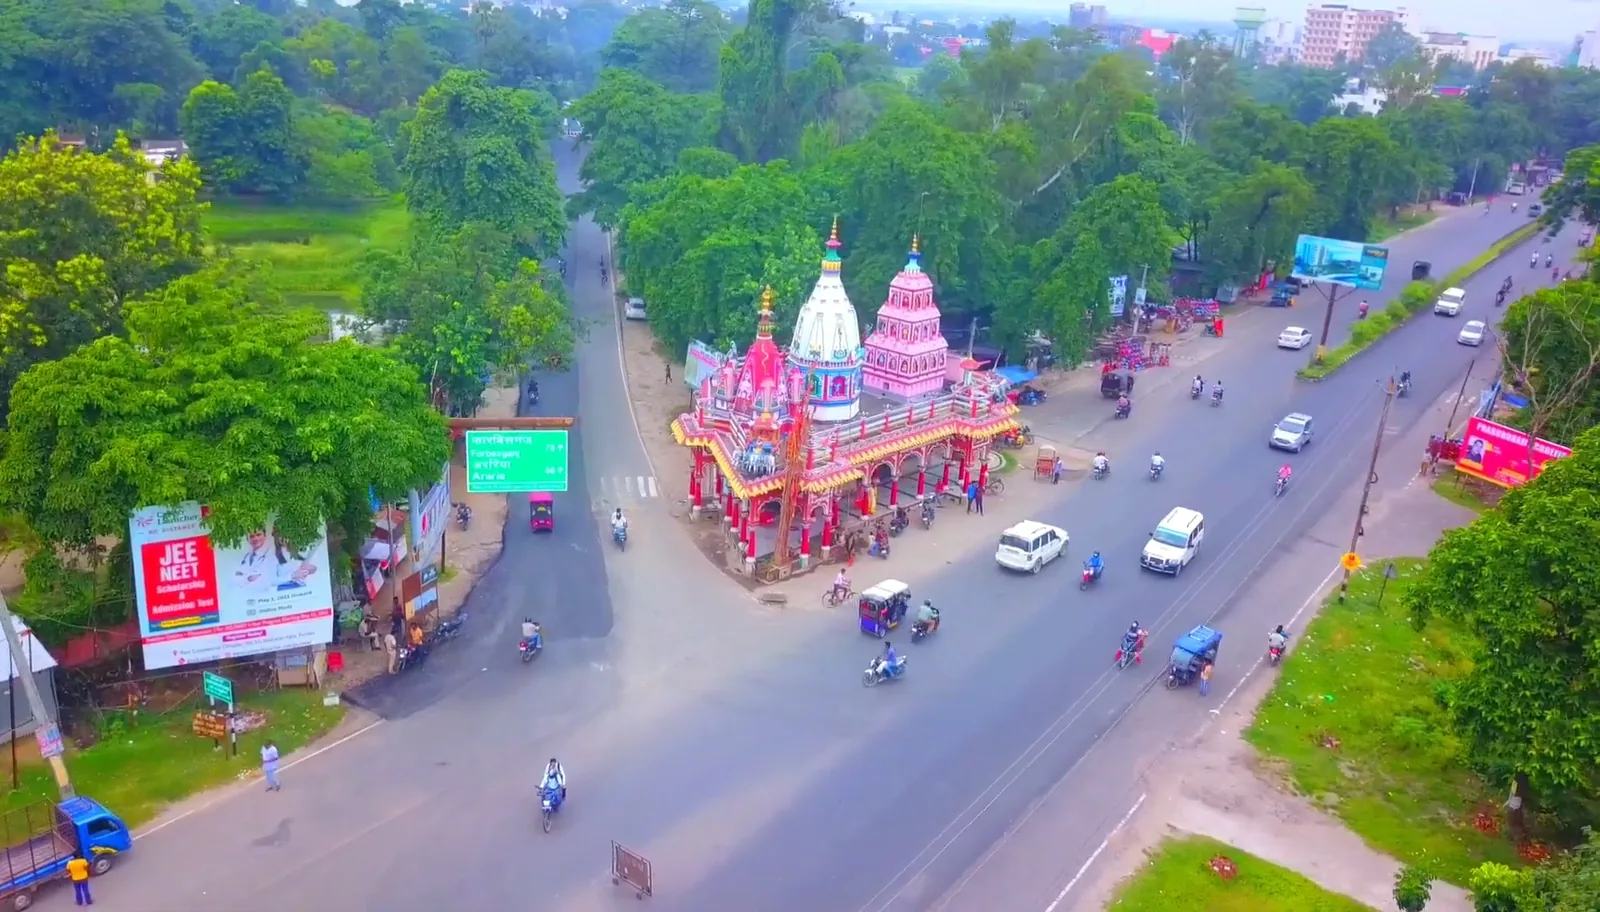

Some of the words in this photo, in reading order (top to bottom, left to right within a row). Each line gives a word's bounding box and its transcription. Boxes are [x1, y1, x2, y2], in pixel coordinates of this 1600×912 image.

[473, 472, 506, 480] Araria
[159, 541, 198, 566] JEE
[160, 562, 198, 582] NEET
[156, 580, 206, 594] Scholarship
[152, 601, 196, 614] Admission
[197, 597, 214, 608] Test
